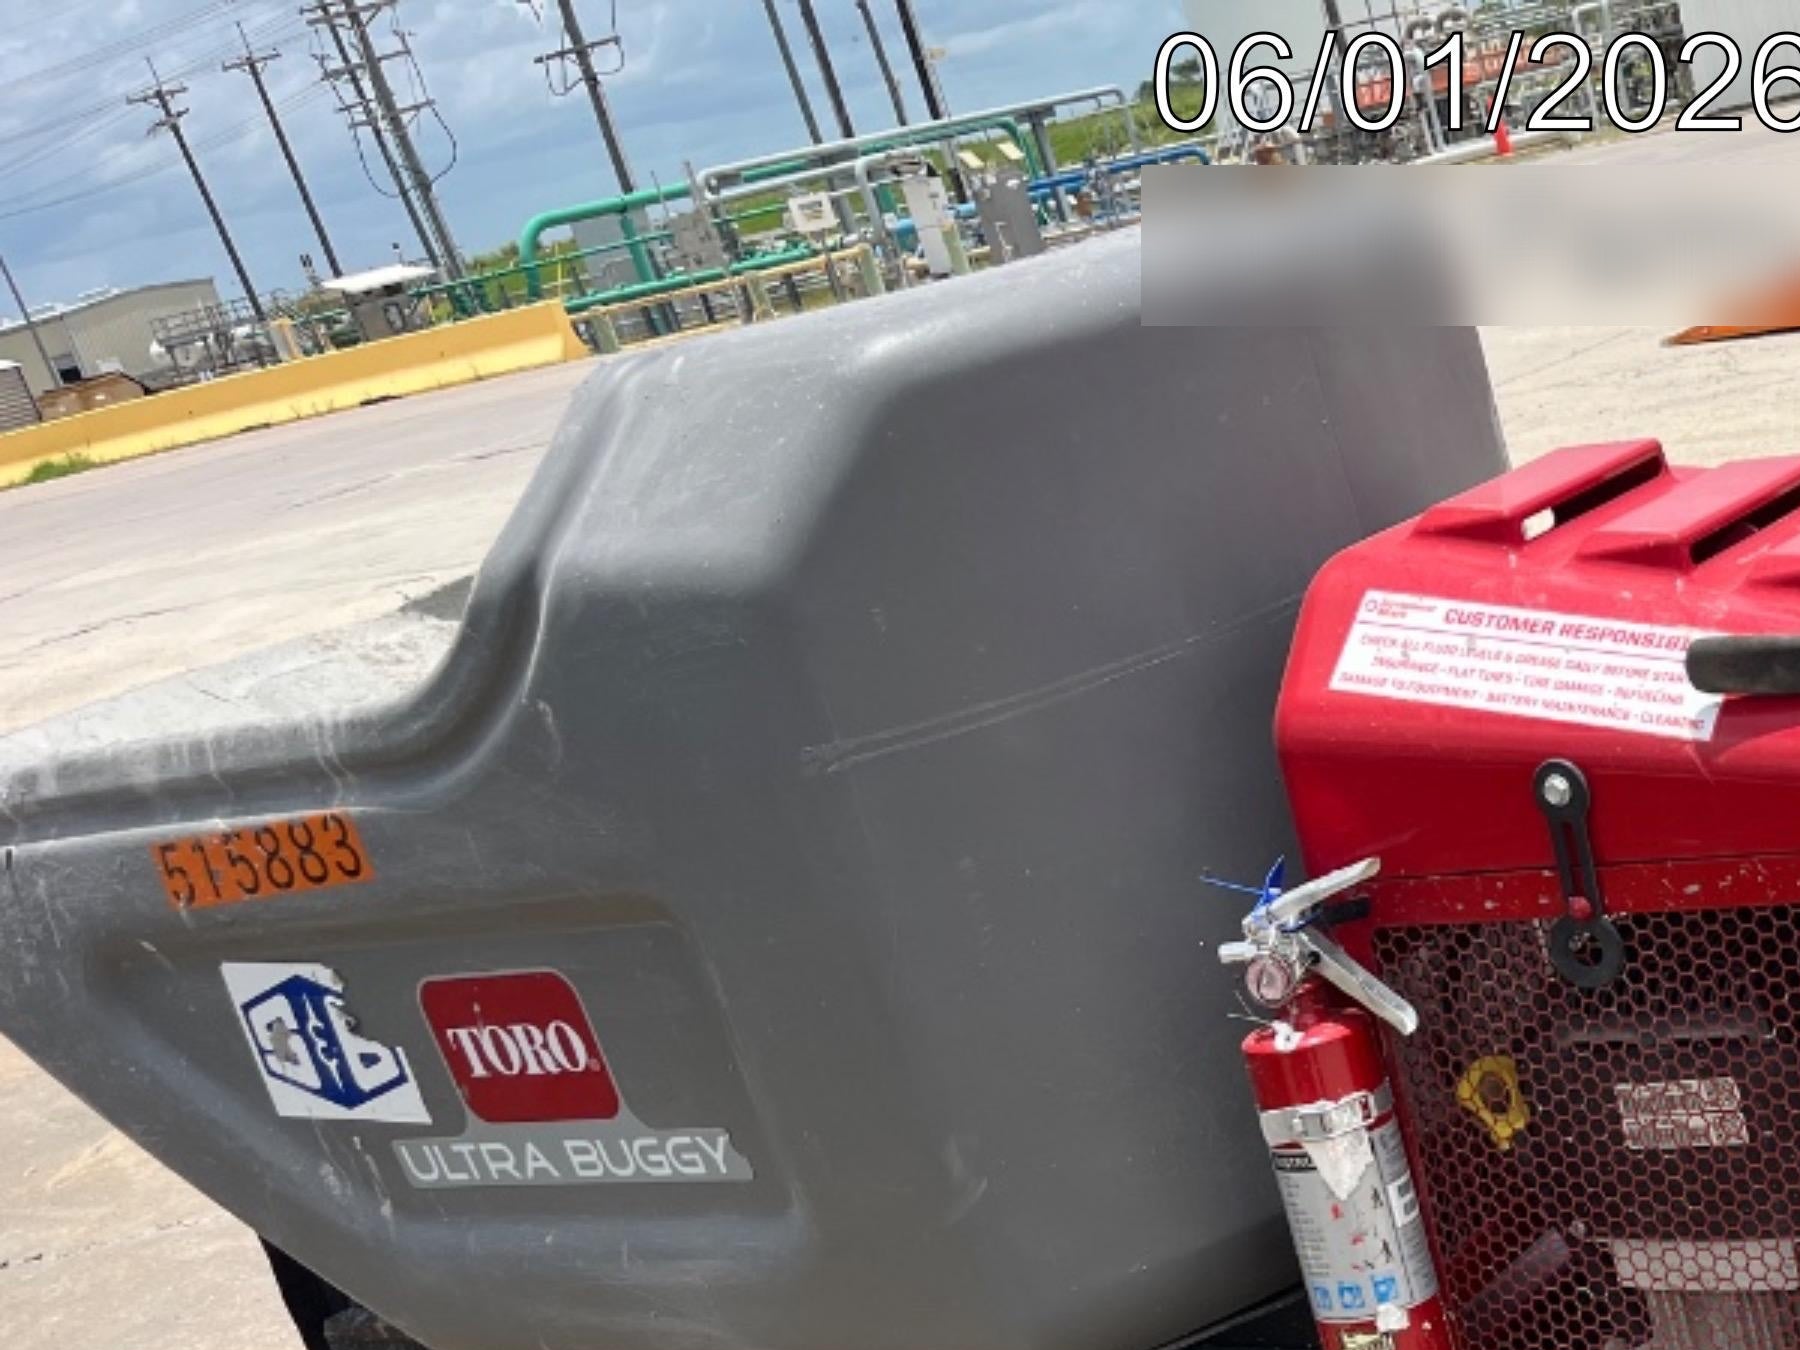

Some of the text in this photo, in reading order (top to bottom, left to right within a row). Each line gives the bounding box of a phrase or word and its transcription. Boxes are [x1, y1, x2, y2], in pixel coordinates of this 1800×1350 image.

[1442, 608, 1556, 635] CUSTOMER
[158, 812, 362, 910] 515883
[446, 1020, 588, 1078] TORO
[399, 1132, 735, 1184] ULTRA BUGGY
